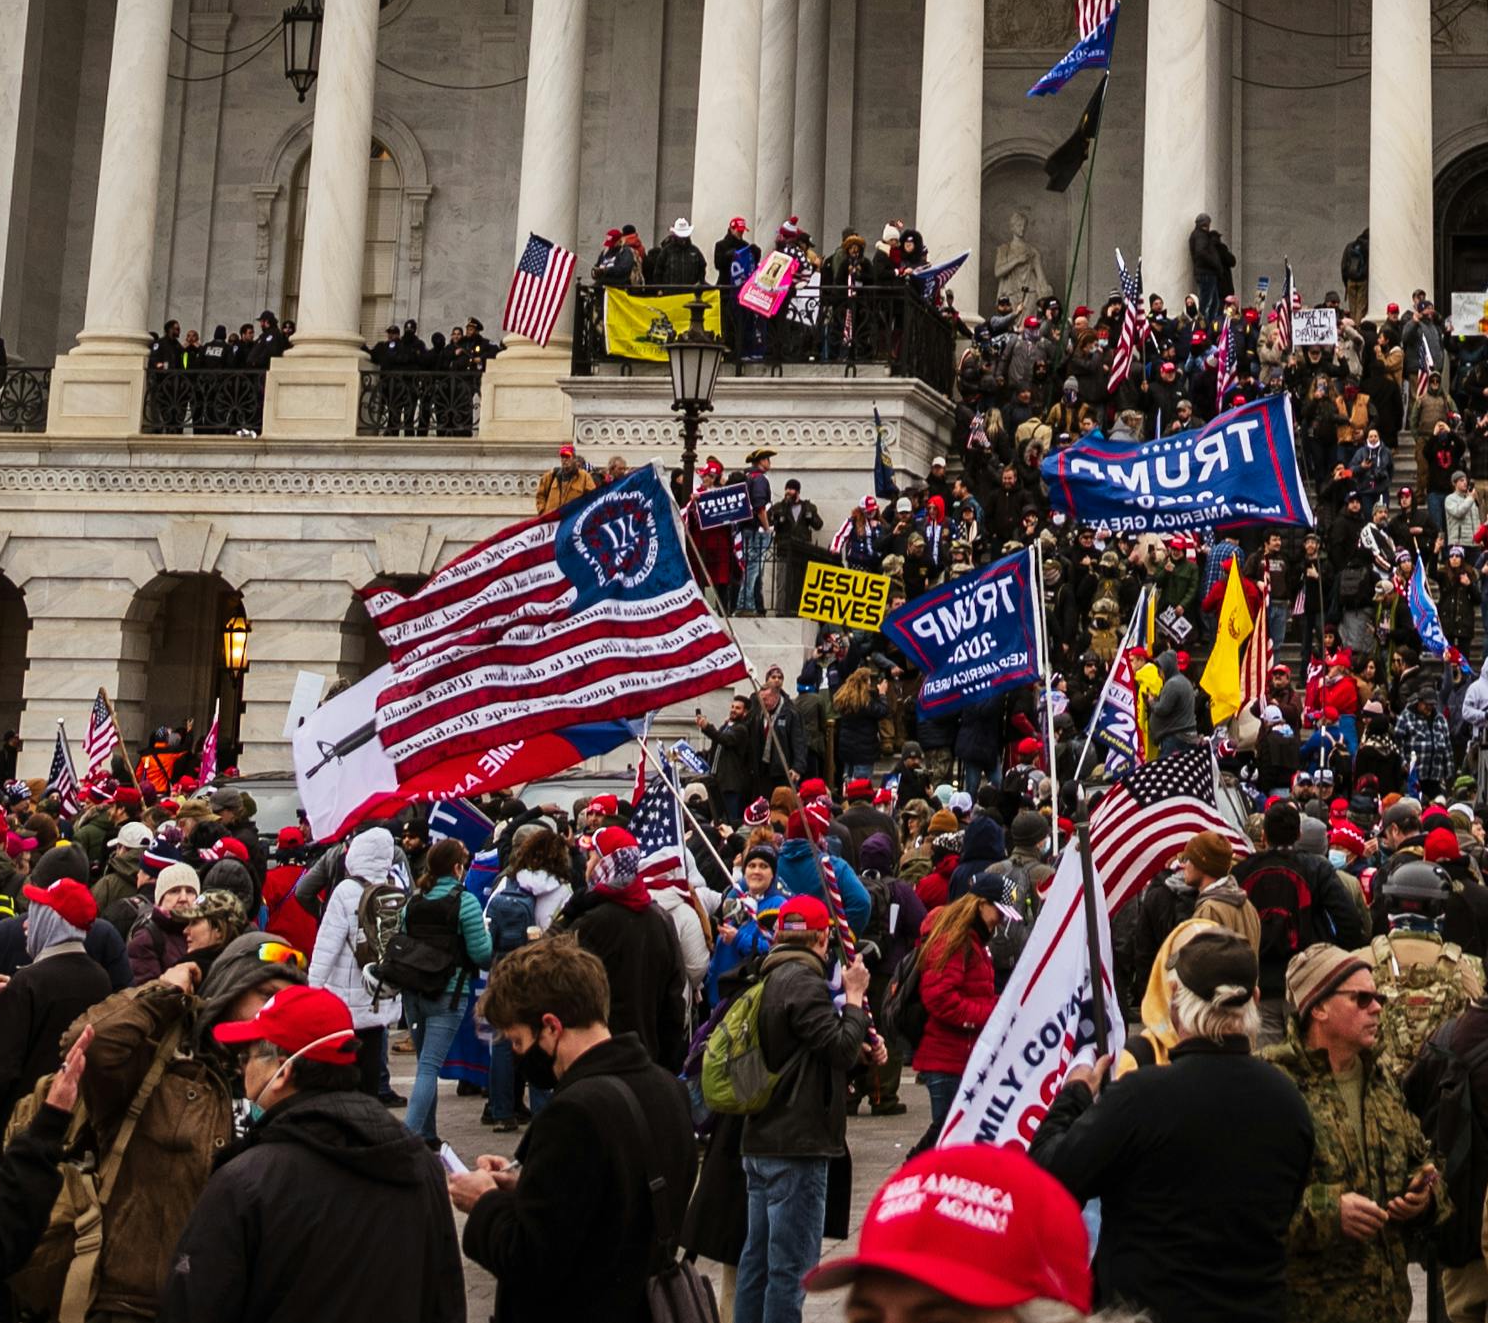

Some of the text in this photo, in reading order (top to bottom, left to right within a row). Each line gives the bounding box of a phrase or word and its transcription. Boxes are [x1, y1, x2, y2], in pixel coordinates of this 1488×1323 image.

[699, 493, 746, 509] TRUMP
[704, 502, 743, 515] PENCE
[807, 567, 887, 603] JESUS
[802, 594, 884, 627] SAVES
[974, 1063, 1023, 1145] MILY
[921, 1173, 1013, 1213] AMERICA
[935, 1195, 1009, 1234] AGAIN!
